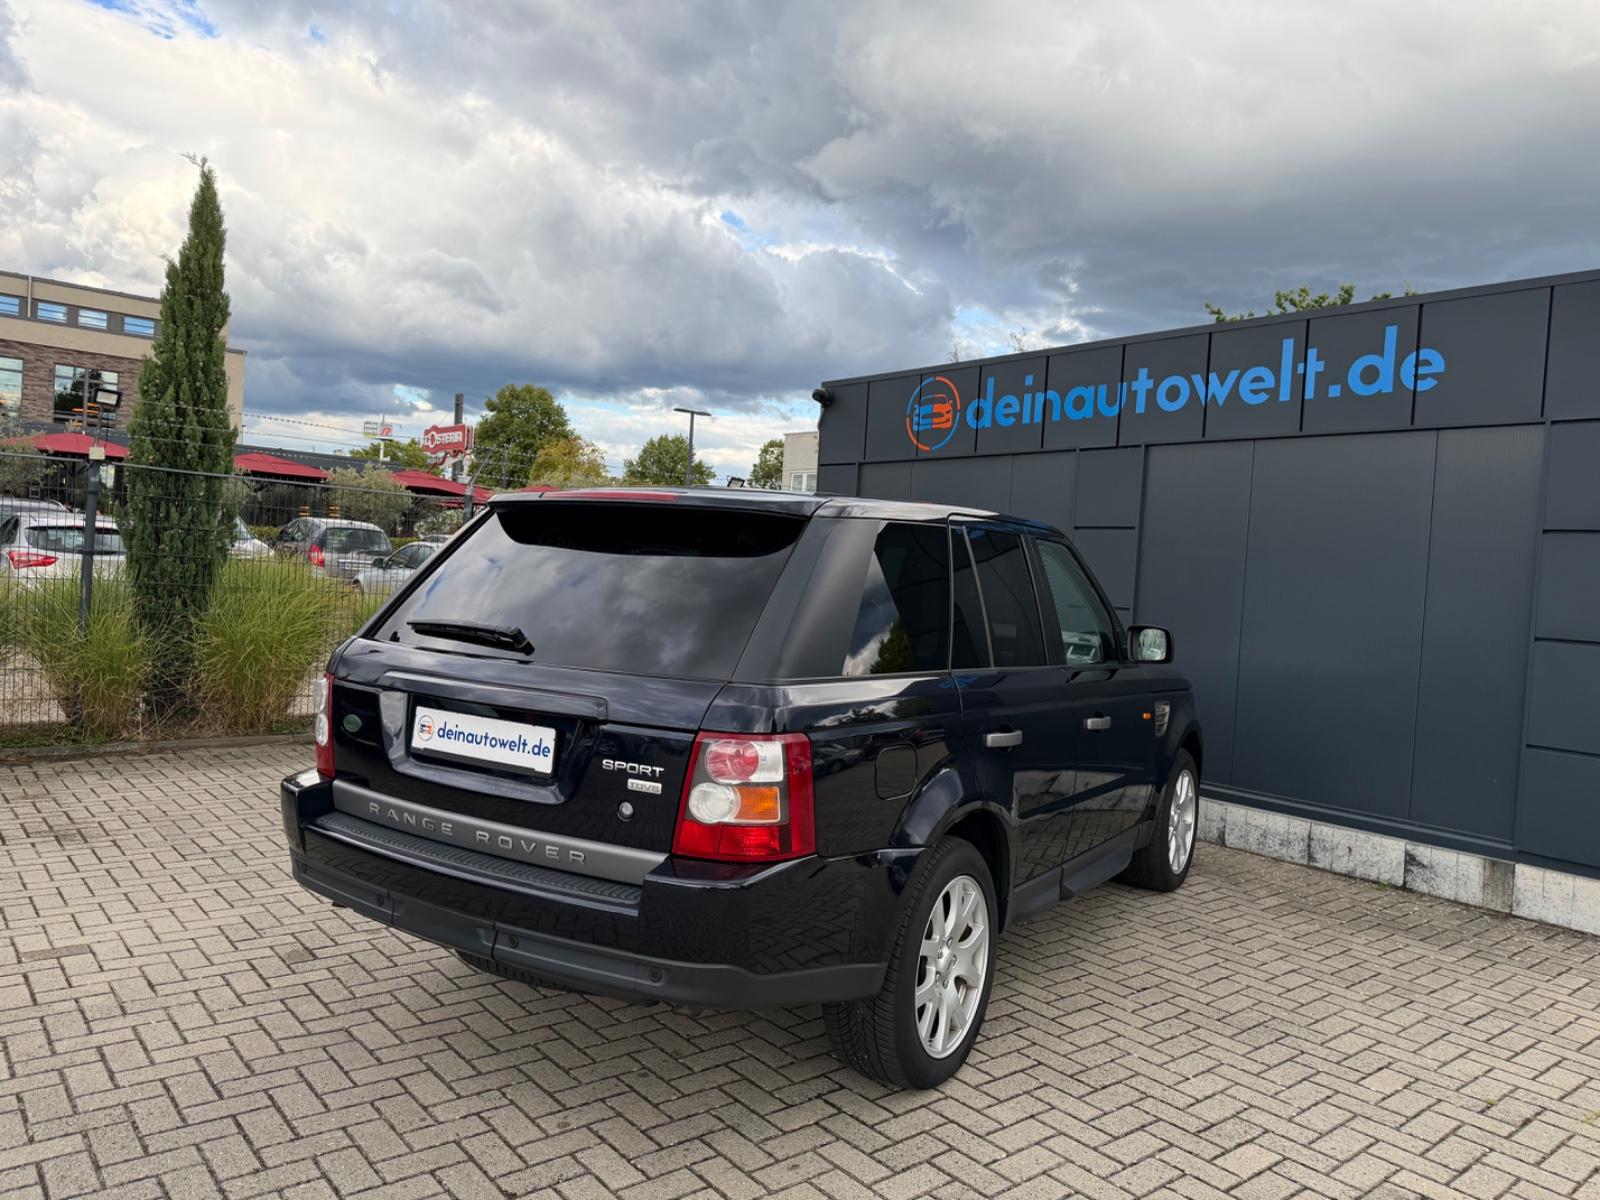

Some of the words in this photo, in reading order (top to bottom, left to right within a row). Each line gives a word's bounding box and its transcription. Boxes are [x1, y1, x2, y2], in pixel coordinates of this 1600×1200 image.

[966, 325, 1445, 429] deinautowelt.de
[437, 721, 551, 758] deinautowelt.de
[602, 758, 664, 778] SPORT
[369, 801, 453, 835] RANGE
[476, 830, 586, 865] ROVER
